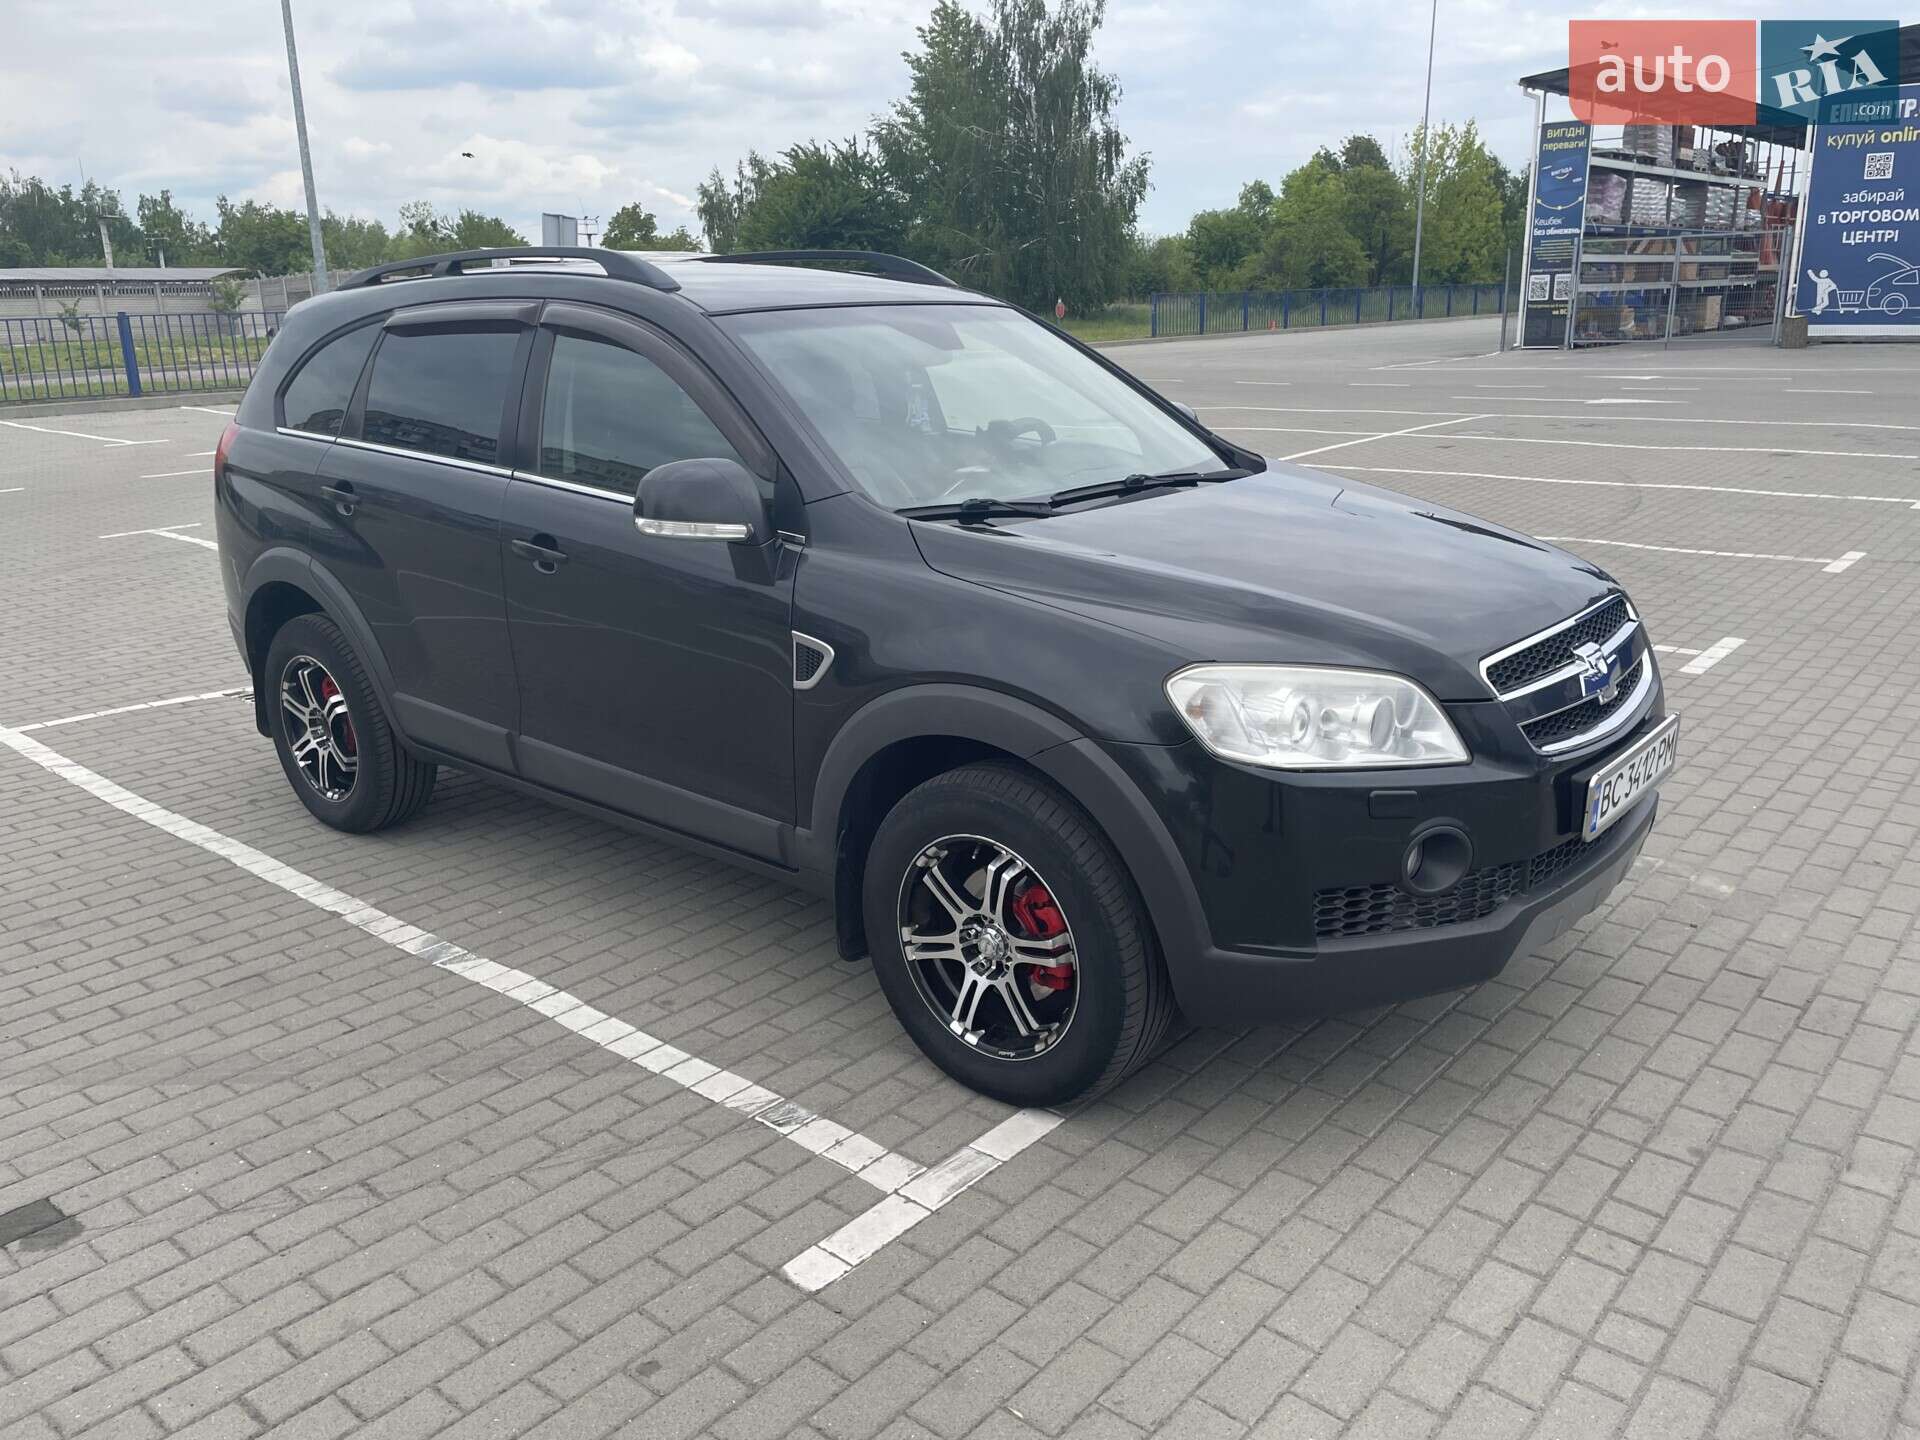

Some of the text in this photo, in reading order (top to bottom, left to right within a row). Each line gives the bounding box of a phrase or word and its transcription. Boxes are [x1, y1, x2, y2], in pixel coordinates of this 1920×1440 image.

[1542, 139, 1587, 151] переваги!
[1827, 129, 1876, 149] купуй
[1842, 188, 1905, 205] забирай
[1817, 208, 1920, 224] в ТОРГОВОМ
[1841, 229, 1899, 245] ЦЕНТРІ
